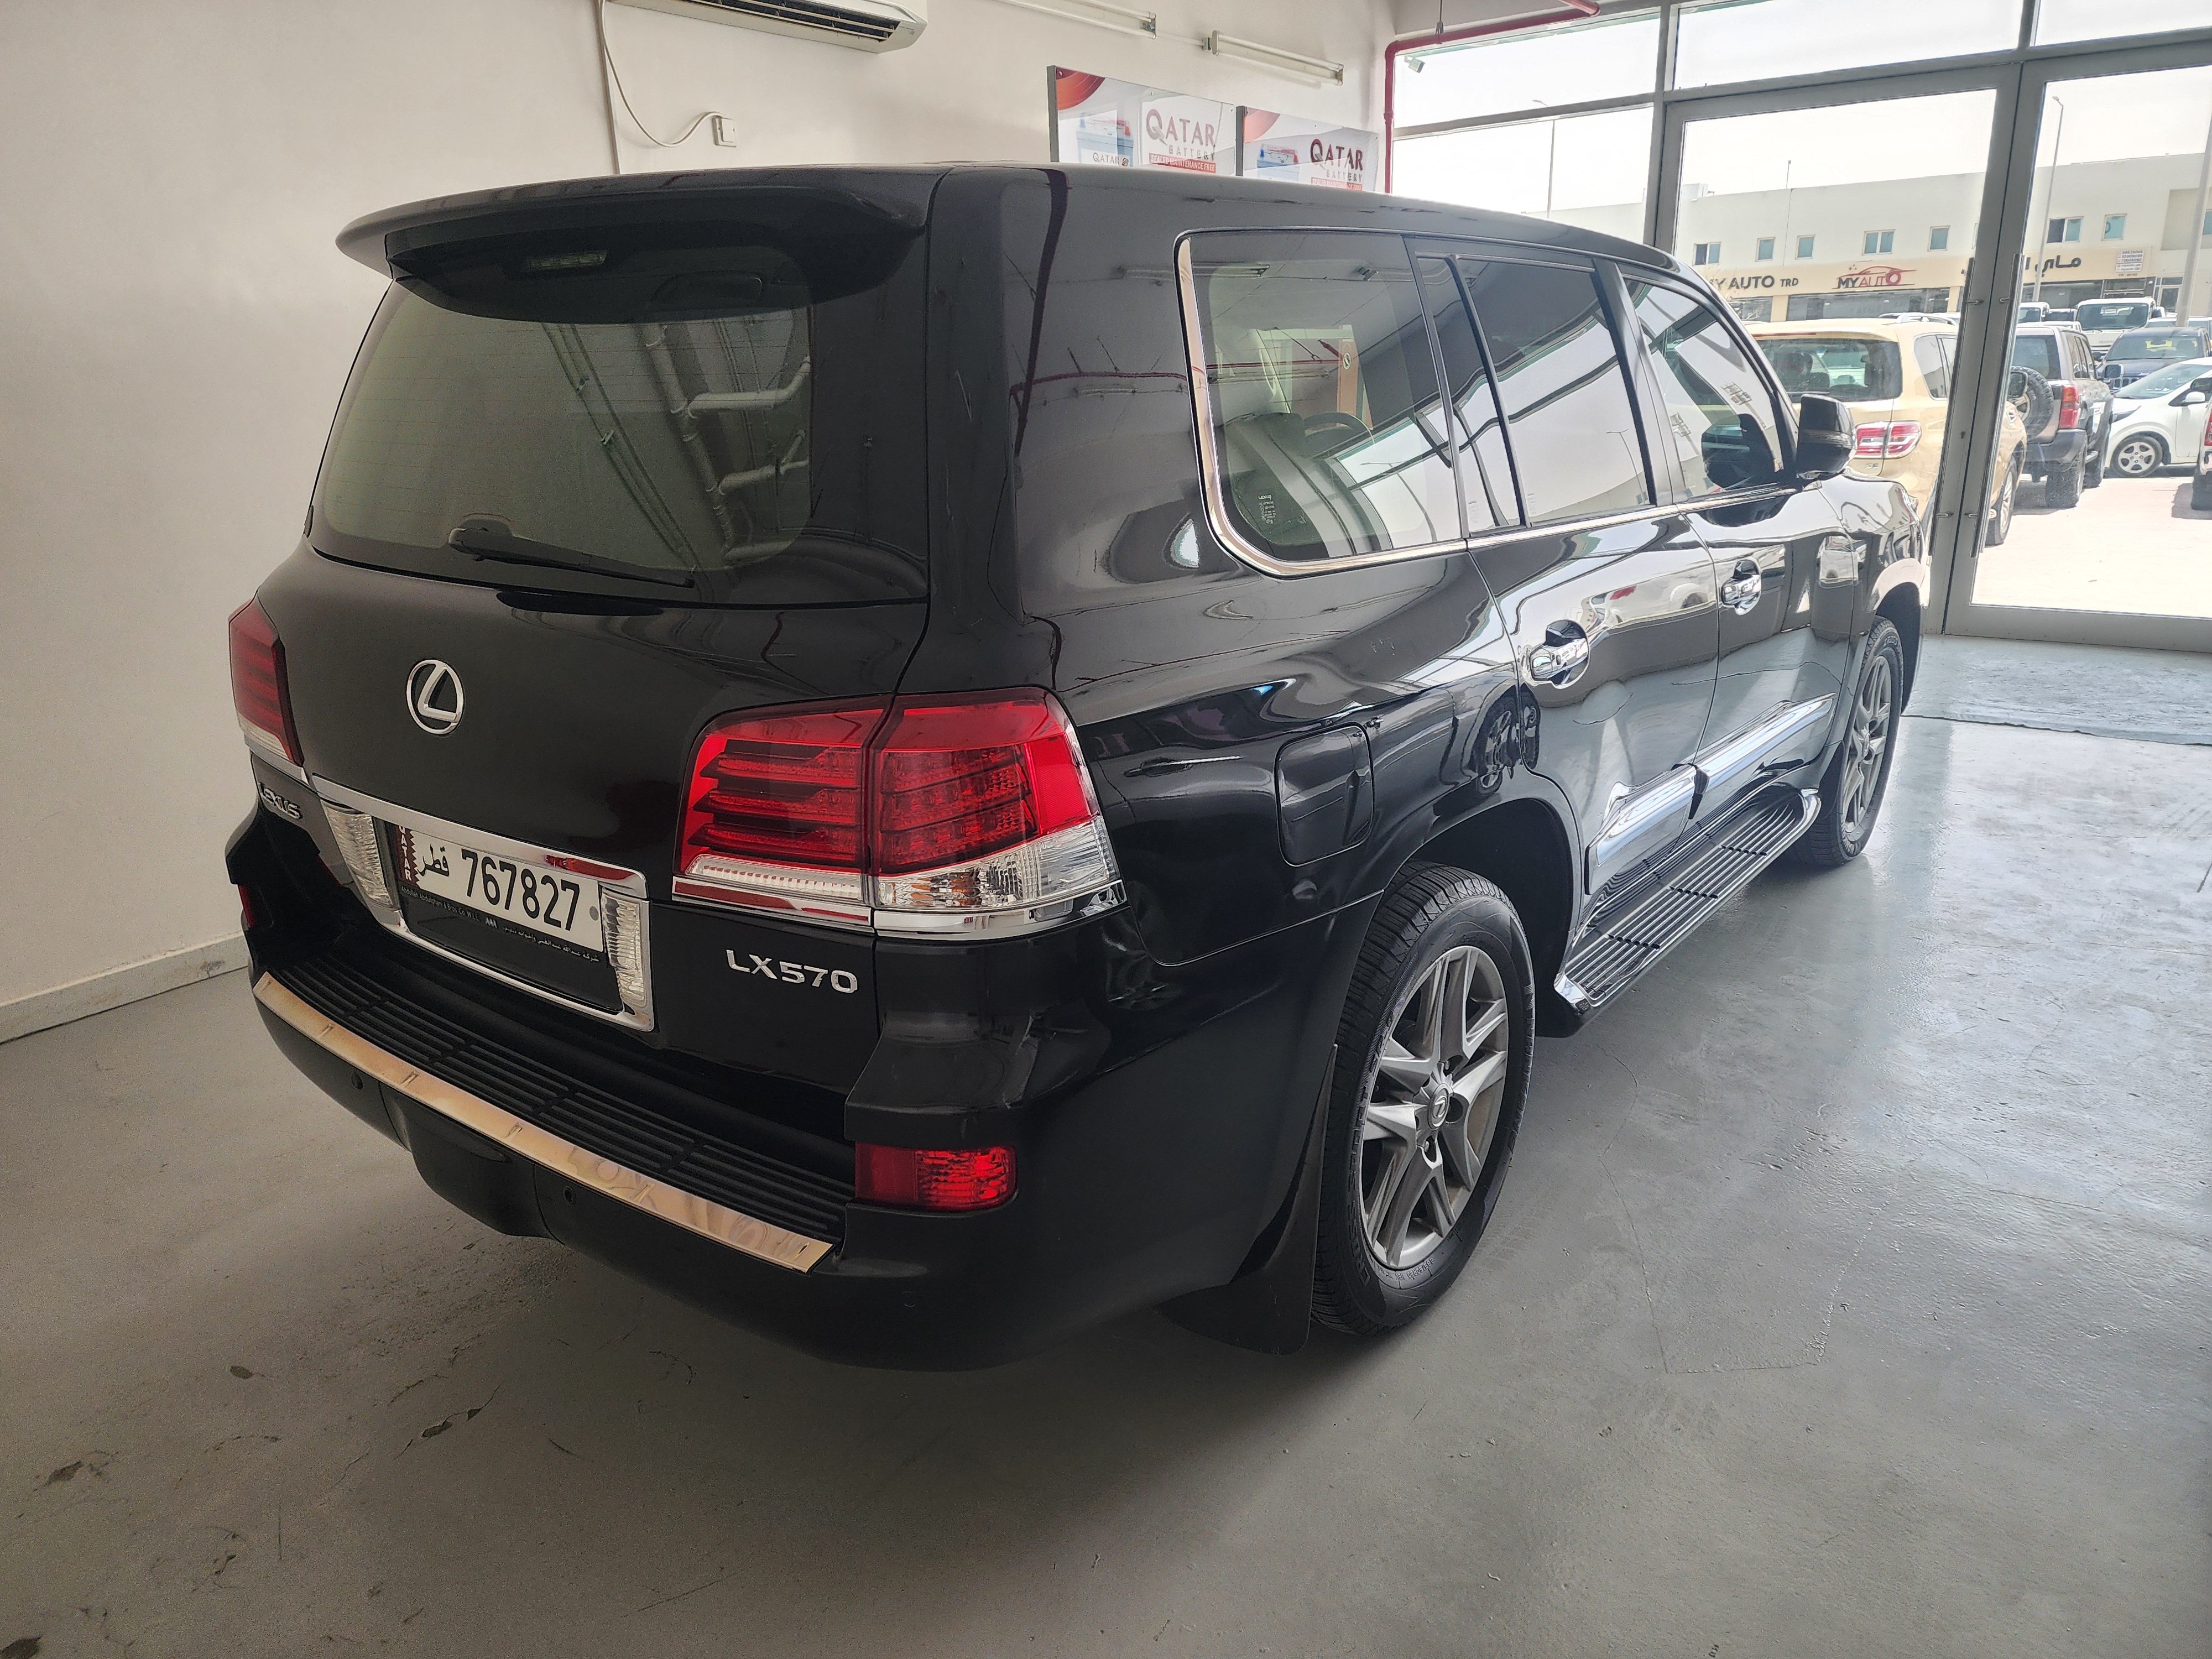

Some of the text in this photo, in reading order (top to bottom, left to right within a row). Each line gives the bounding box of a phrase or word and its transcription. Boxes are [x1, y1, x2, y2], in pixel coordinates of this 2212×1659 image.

[1146, 108, 1215, 147] QATAR
[1093, 152, 1120, 166] QATAR
[1151, 155, 1215, 172] SEALED MAINTENANCE FREE
[1168, 144, 1215, 161] BATTERY
[1310, 138, 1364, 171] QATAR
[1326, 169, 1363, 183] BATTERY
[1728, 275, 1775, 290] AUTO
[1780, 278, 1799, 288] TRD
[258, 782, 300, 820] LEXUS
[417, 844, 450, 877] قطر
[461, 848, 580, 931] 767827
[726, 950, 858, 993] LX570
[1347, 1199, 1370, 1288] CROSS
